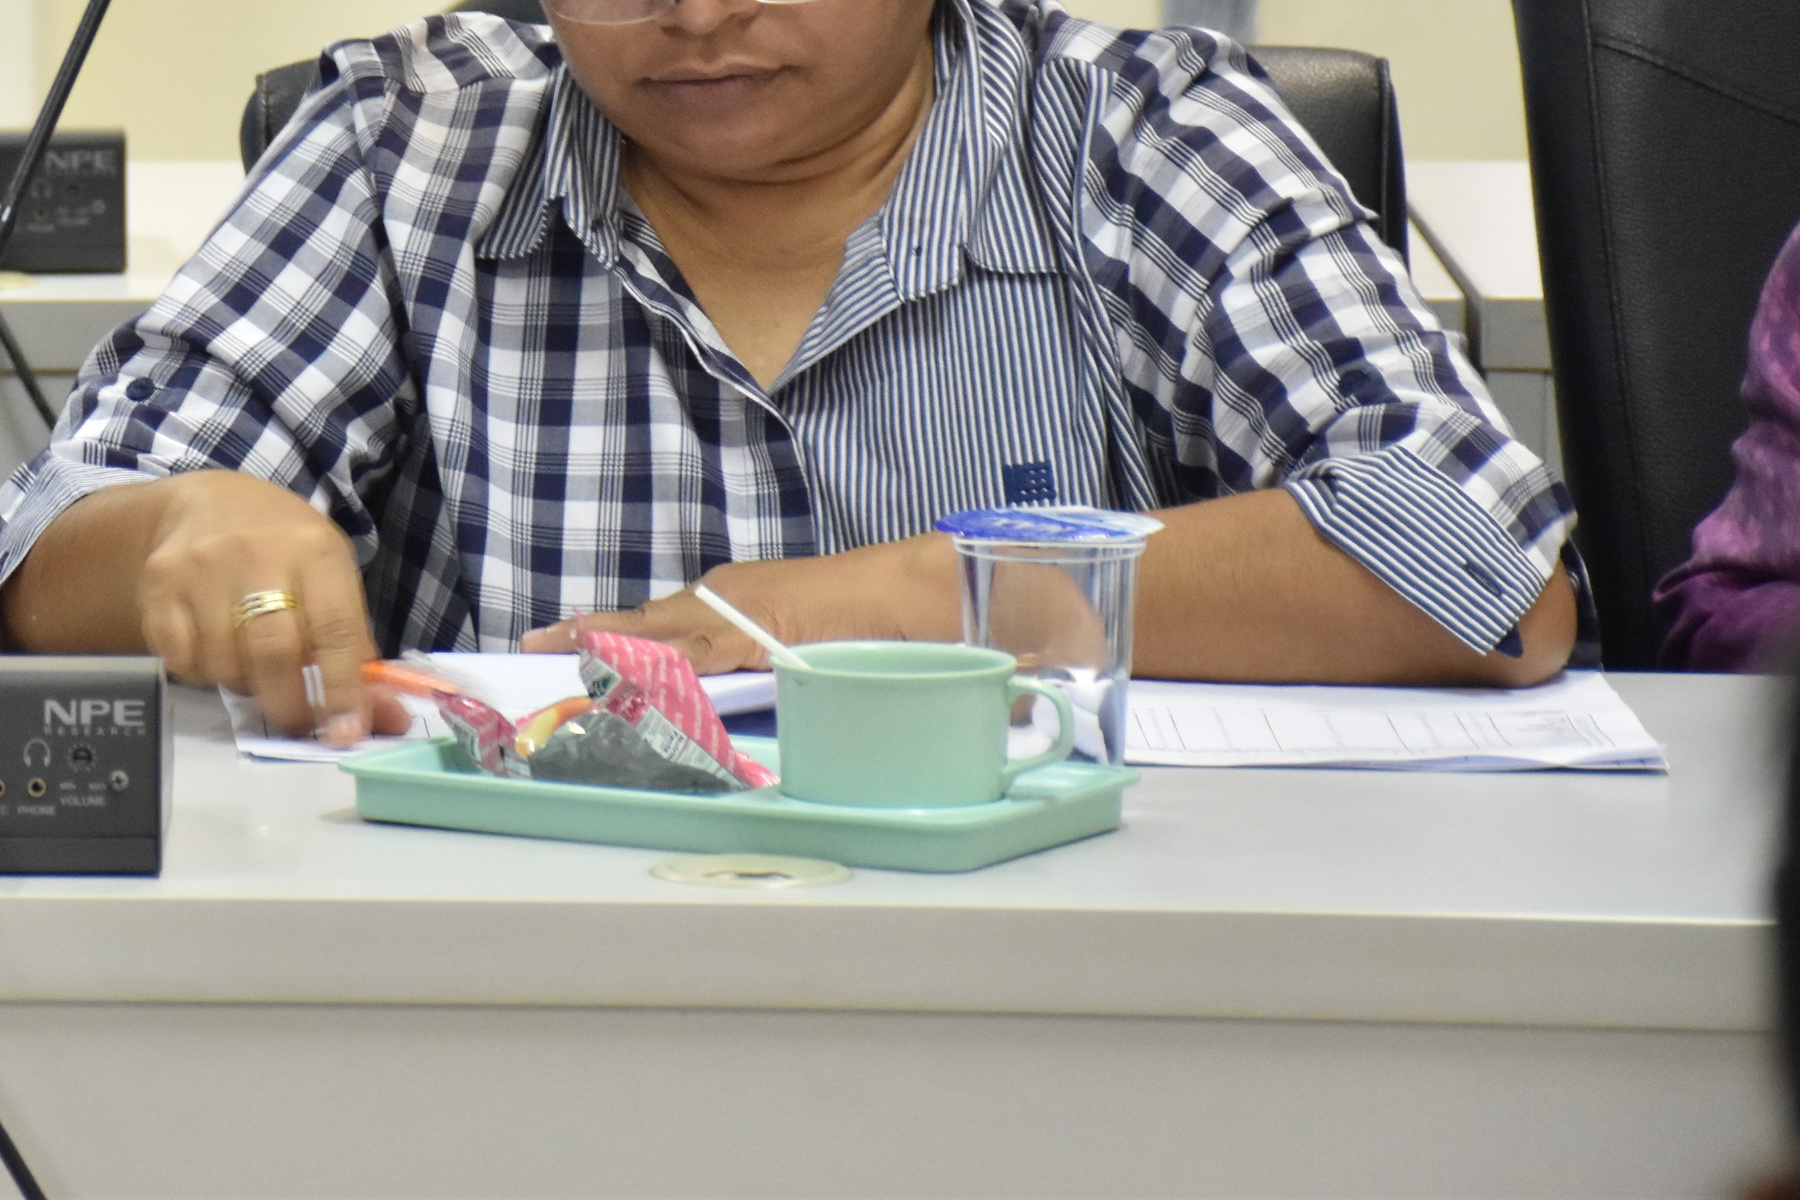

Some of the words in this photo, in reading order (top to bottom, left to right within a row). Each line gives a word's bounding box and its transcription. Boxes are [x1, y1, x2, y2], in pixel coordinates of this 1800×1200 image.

[43, 699, 146, 726] NPE
[59, 794, 107, 807] VOLUME
[16, 803, 57, 817] PHONE
